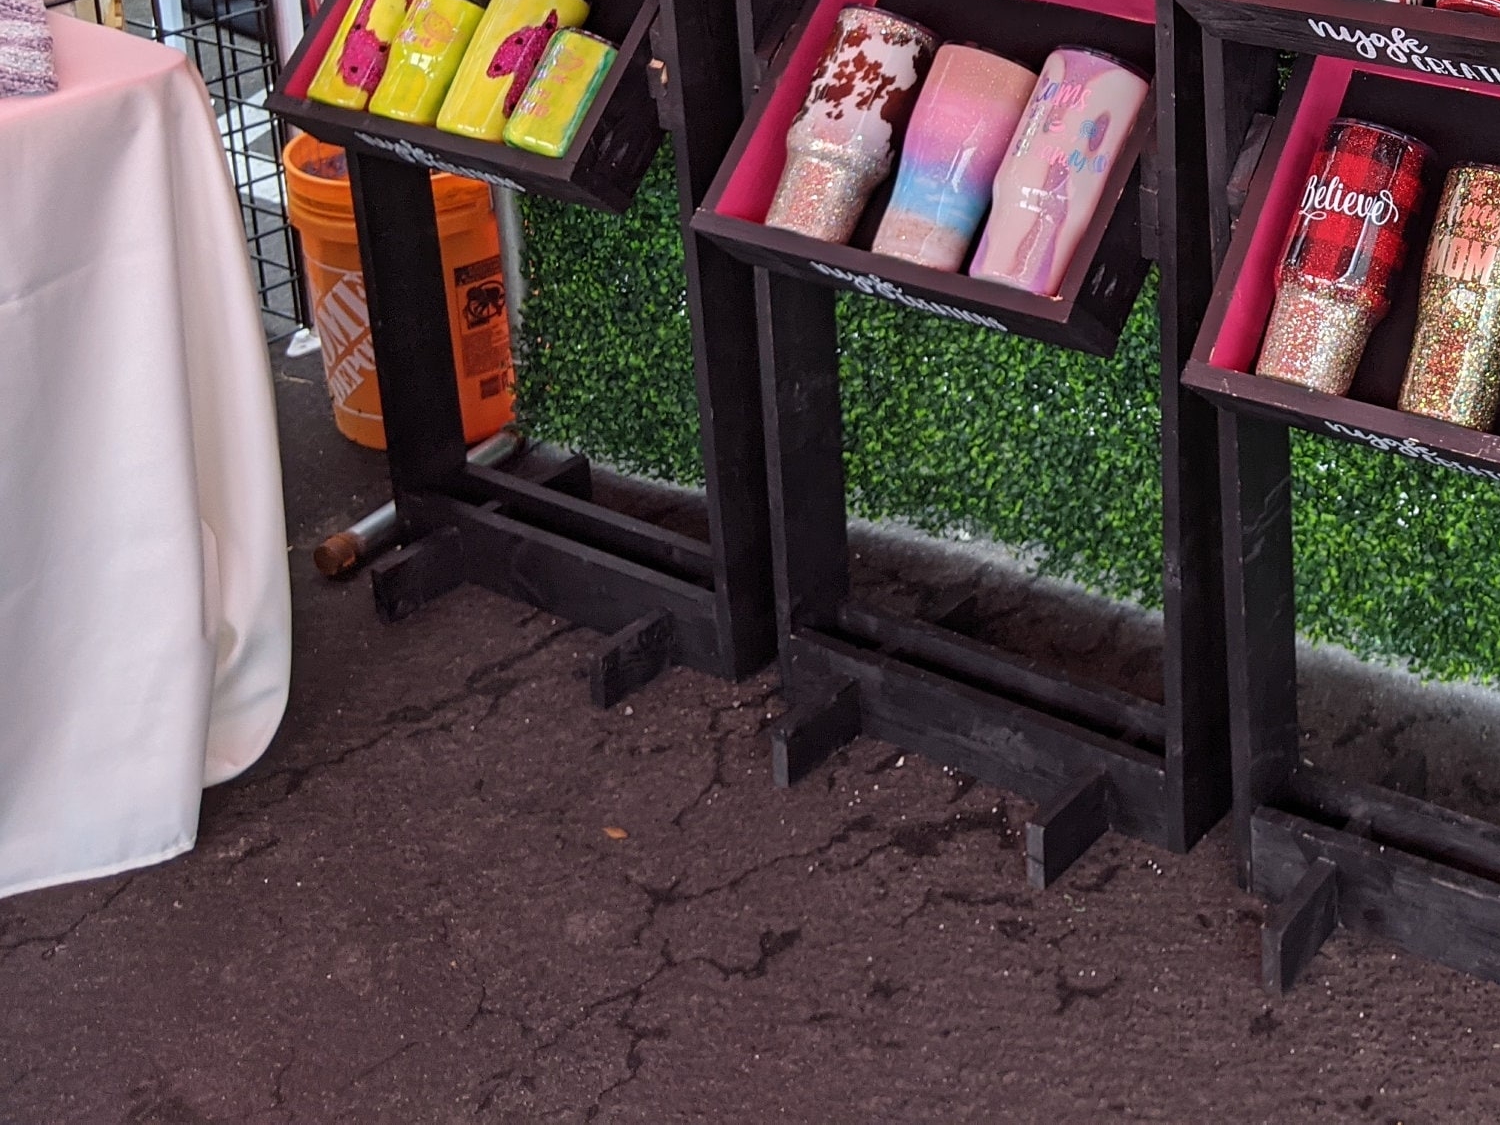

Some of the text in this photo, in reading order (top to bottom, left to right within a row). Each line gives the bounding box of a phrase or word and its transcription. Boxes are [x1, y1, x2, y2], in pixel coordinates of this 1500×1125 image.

[1307, 18, 1429, 64] nygk
[1298, 174, 1399, 225] Believe
[1427, 235, 1497, 286] MOM
